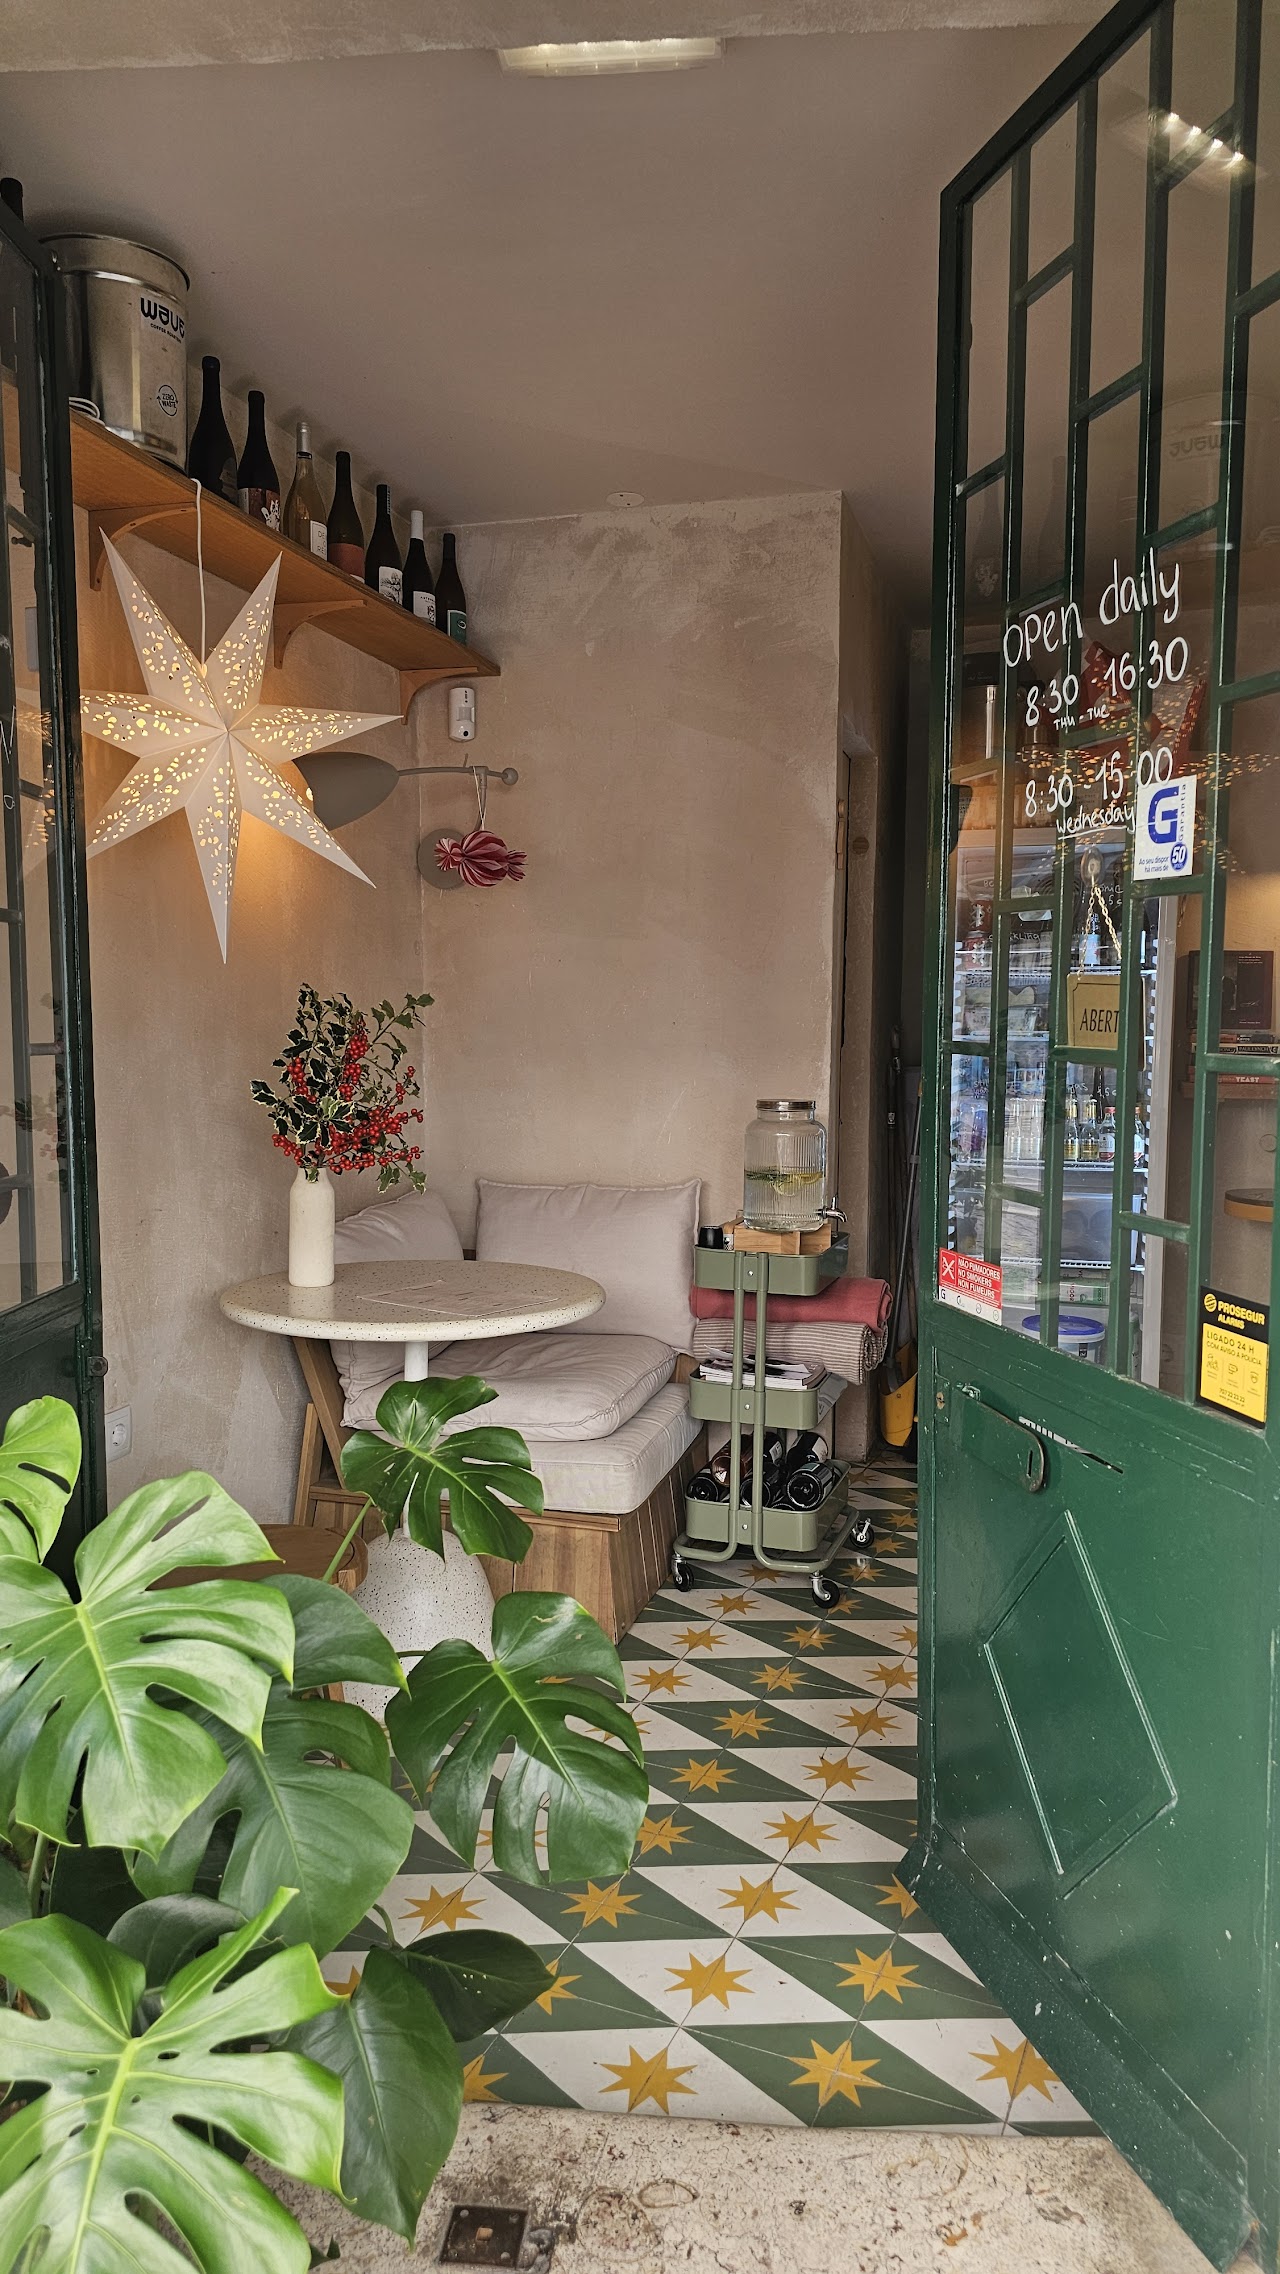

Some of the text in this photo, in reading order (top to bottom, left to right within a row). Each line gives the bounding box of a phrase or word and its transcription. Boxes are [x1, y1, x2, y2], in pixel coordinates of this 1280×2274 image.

[161, 393, 175, 401] ZERO
[1100, 547, 1179, 624] daily
[1026, 674, 1079, 726] 8:30
[1025, 774, 1074, 817] 8:30
[1171, 846, 1186, 864] 50
[958, 1268, 992, 1287] NO SMOKERS
[969, 1261, 1001, 1280] FUMADORES
[958, 1278, 995, 1299] NON FUMEURS
[1217, 1314, 1245, 1330] ALARMS
[1218, 1300, 1265, 1326] PROSEGUR
[1206, 1330, 1255, 1354] LIGADO 24 H
[1206, 1340, 1219, 1351] COM
